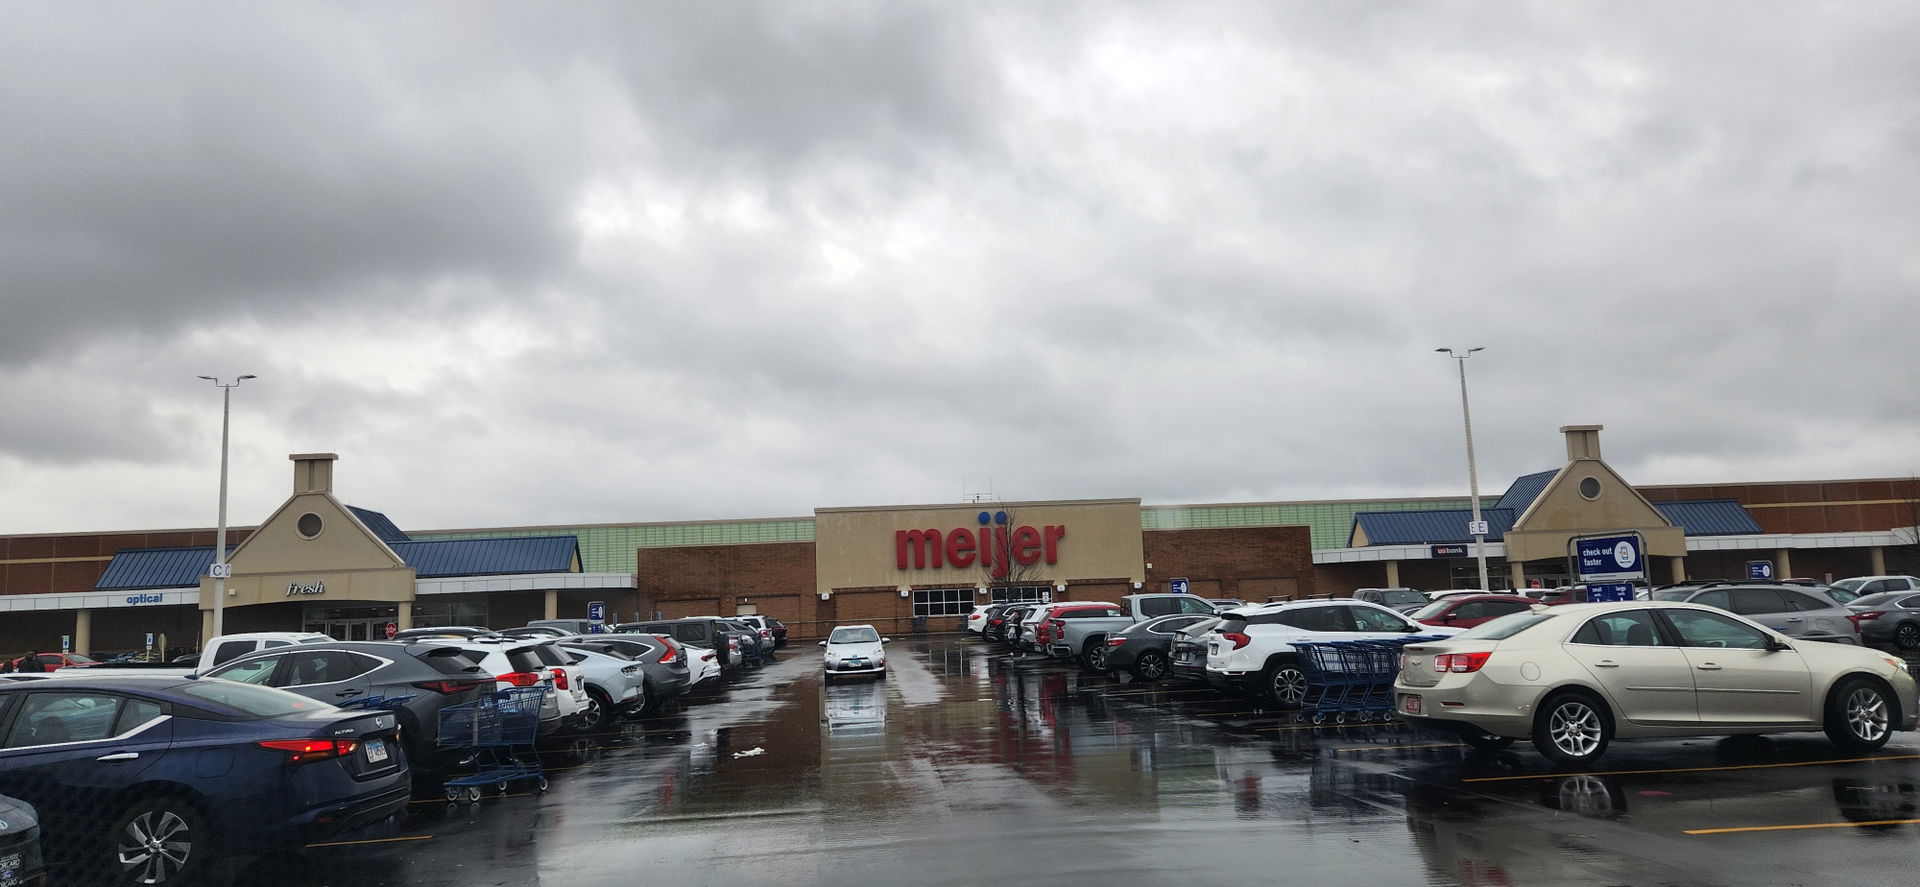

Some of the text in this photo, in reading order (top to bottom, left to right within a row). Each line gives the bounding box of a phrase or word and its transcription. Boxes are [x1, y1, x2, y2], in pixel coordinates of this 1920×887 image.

[1478, 521, 1486, 533] E
[896, 511, 1066, 578] meijer
[1583, 547, 1613, 556] check out
[1584, 558, 1602, 567] faster
[212, 564, 222, 576] C
[286, 580, 325, 597] fresh
[126, 593, 163, 606] optical
